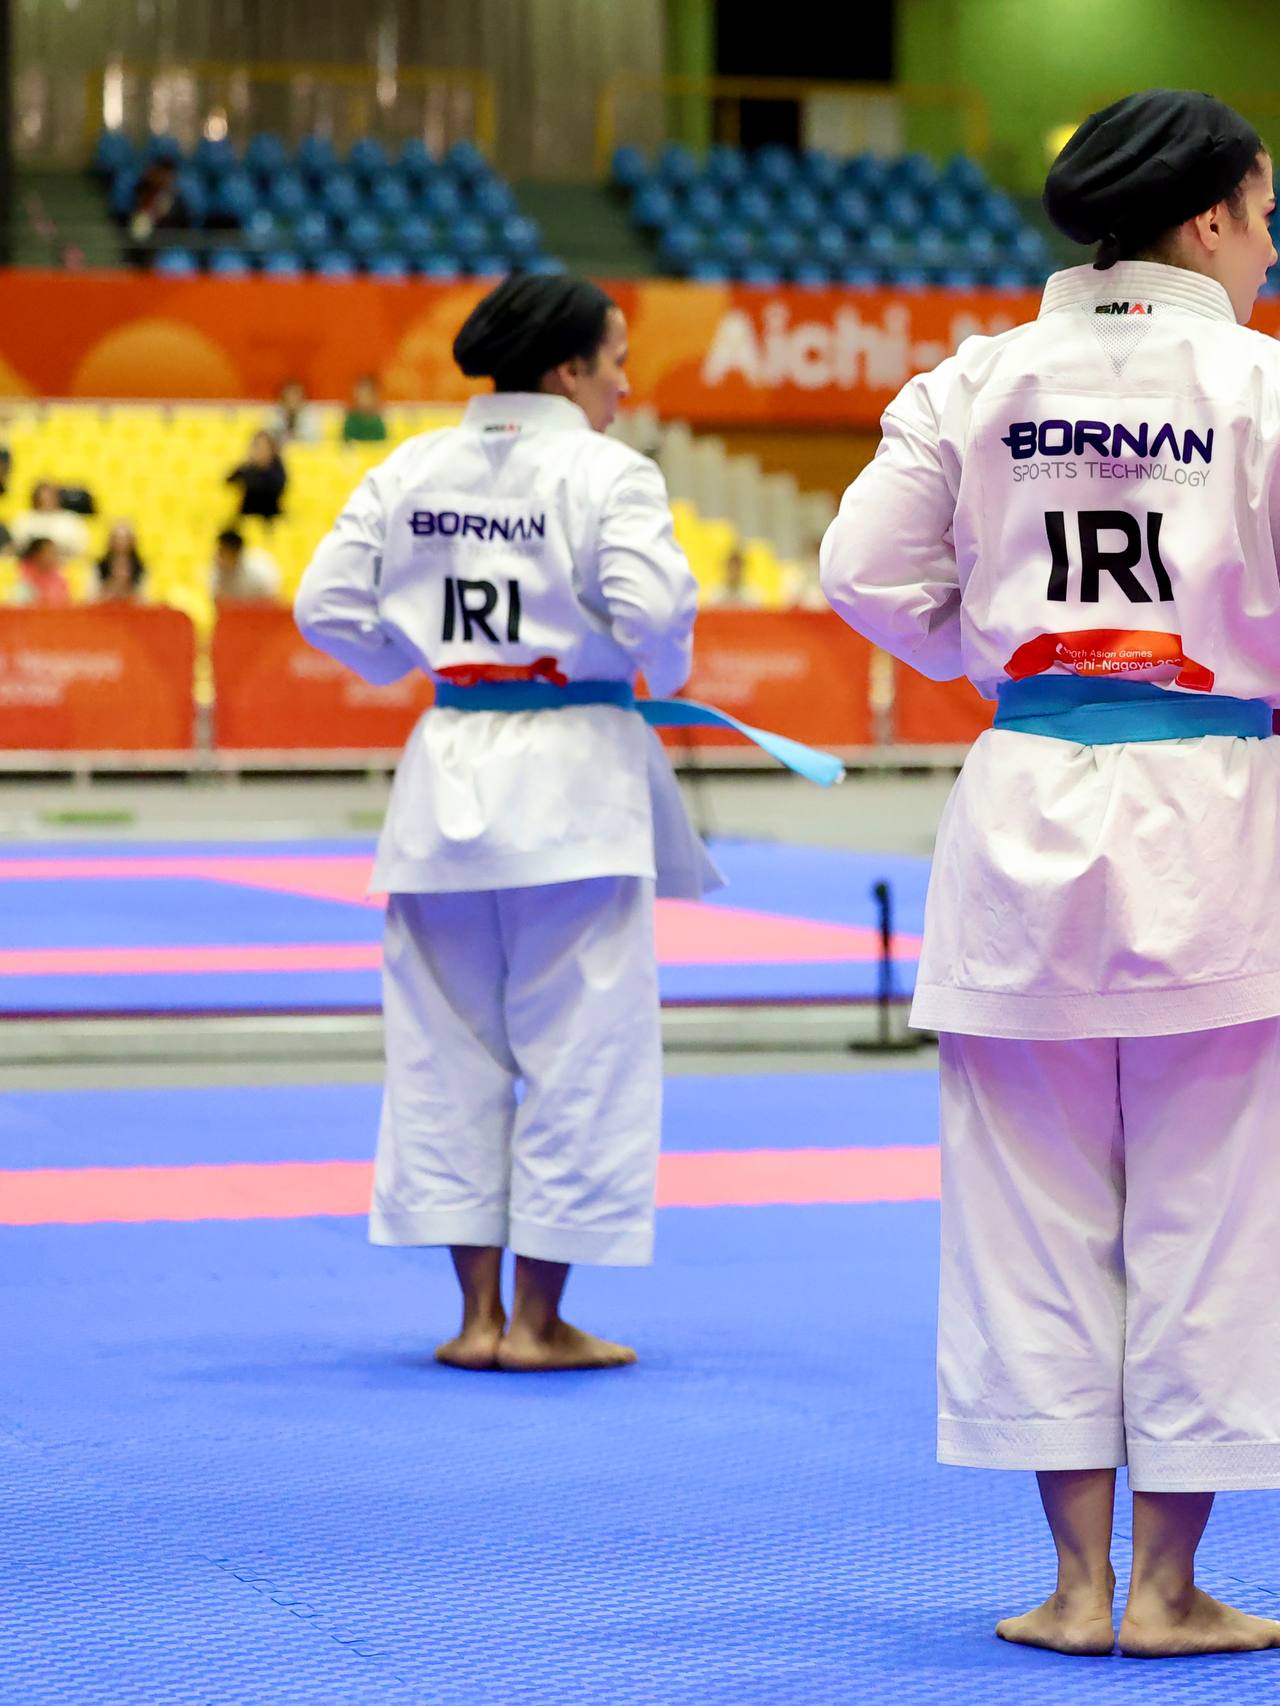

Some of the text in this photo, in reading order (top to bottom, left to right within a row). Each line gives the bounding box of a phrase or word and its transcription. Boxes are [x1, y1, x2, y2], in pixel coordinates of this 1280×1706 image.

[1001, 420, 1214, 464] BORNAN
[1013, 462, 1210, 487] SPORTS TECHNOLOGY
[408, 511, 545, 541] BORNAN
[1044, 510, 1175, 603] IRI
[443, 577, 520, 642] IRI
[1073, 658, 1153, 671] ichi-Nagoya
[1090, 649, 1116, 659] Asian
[1119, 650, 1153, 658] Games
